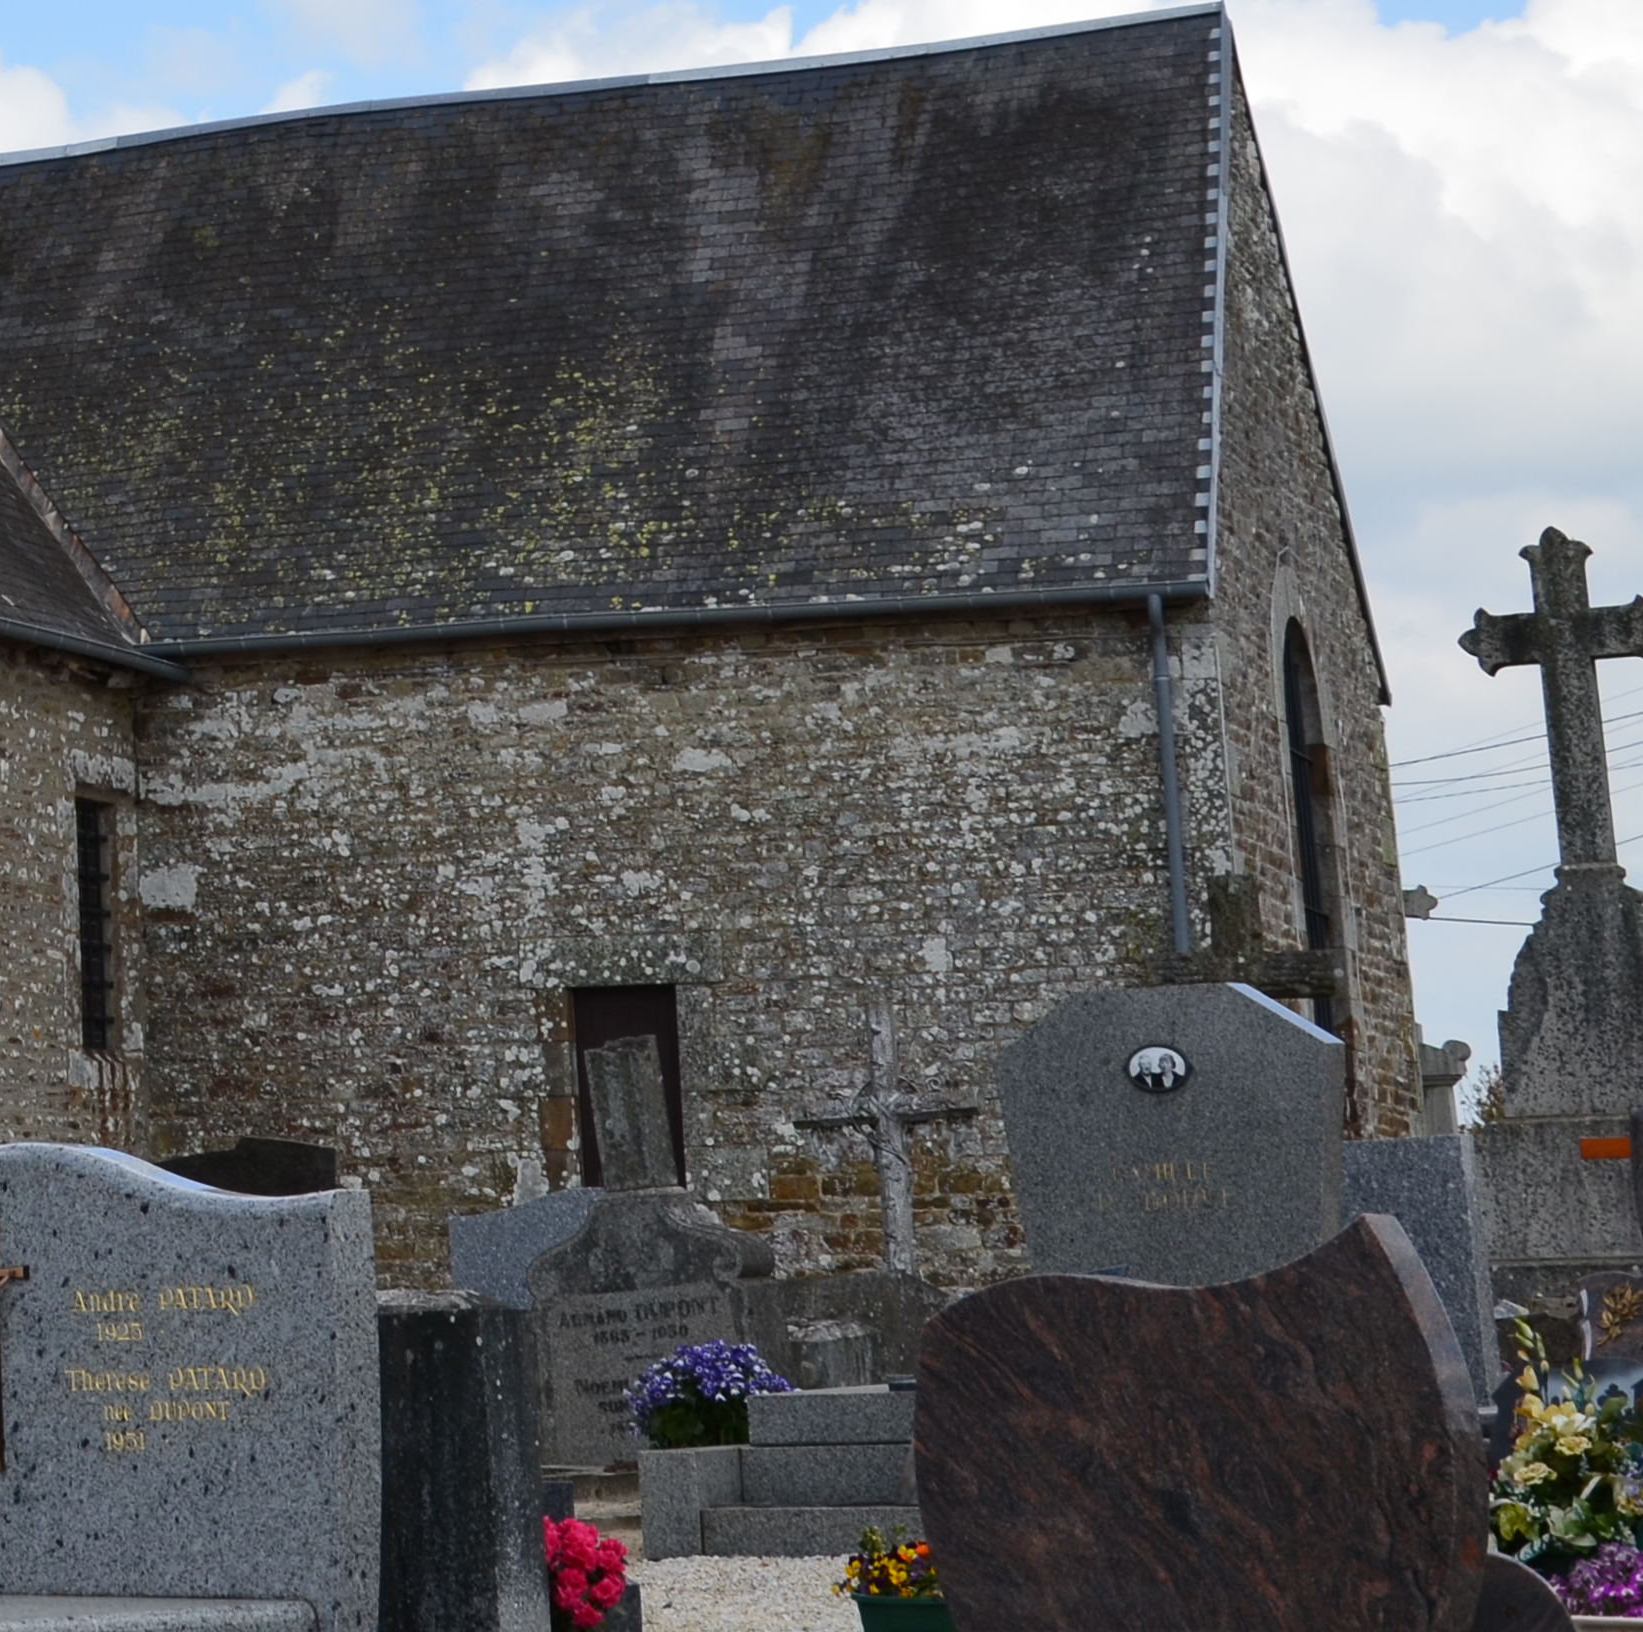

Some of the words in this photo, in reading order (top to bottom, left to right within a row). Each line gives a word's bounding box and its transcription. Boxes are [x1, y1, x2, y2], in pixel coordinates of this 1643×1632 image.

[159, 1284, 256, 1316] PATARD
[635, 1296, 720, 1321] DUPONT
[96, 1322, 143, 1341] 1925
[169, 1365, 268, 1397] PATARD
[149, 1400, 231, 1421] DUPONT
